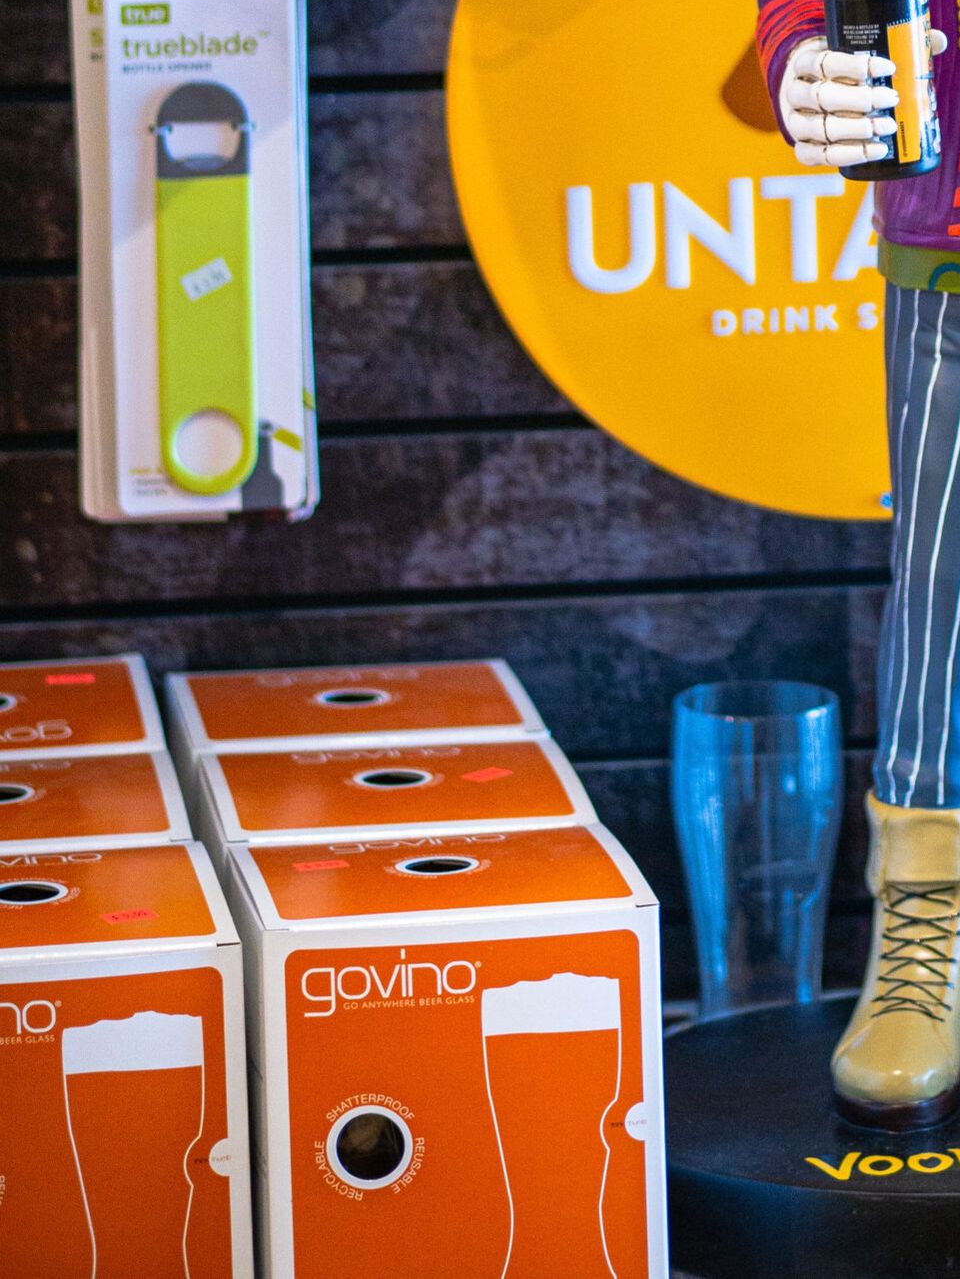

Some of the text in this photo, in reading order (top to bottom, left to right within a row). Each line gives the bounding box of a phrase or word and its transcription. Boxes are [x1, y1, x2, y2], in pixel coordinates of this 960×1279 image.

[711, 303, 839, 337] DRINK
[328, 833, 507, 855] govino
[301, 948, 476, 1018] govino
[343, 995, 475, 1011] GO ANYWHERE BEER GLASS
[25, 1034, 56, 1044] GLASS
[325, 1093, 415, 1122] SHATTERPROOF
[314, 1140, 364, 1201] RECYCLABLE
[390, 1137, 425, 1194] REUSABLE
